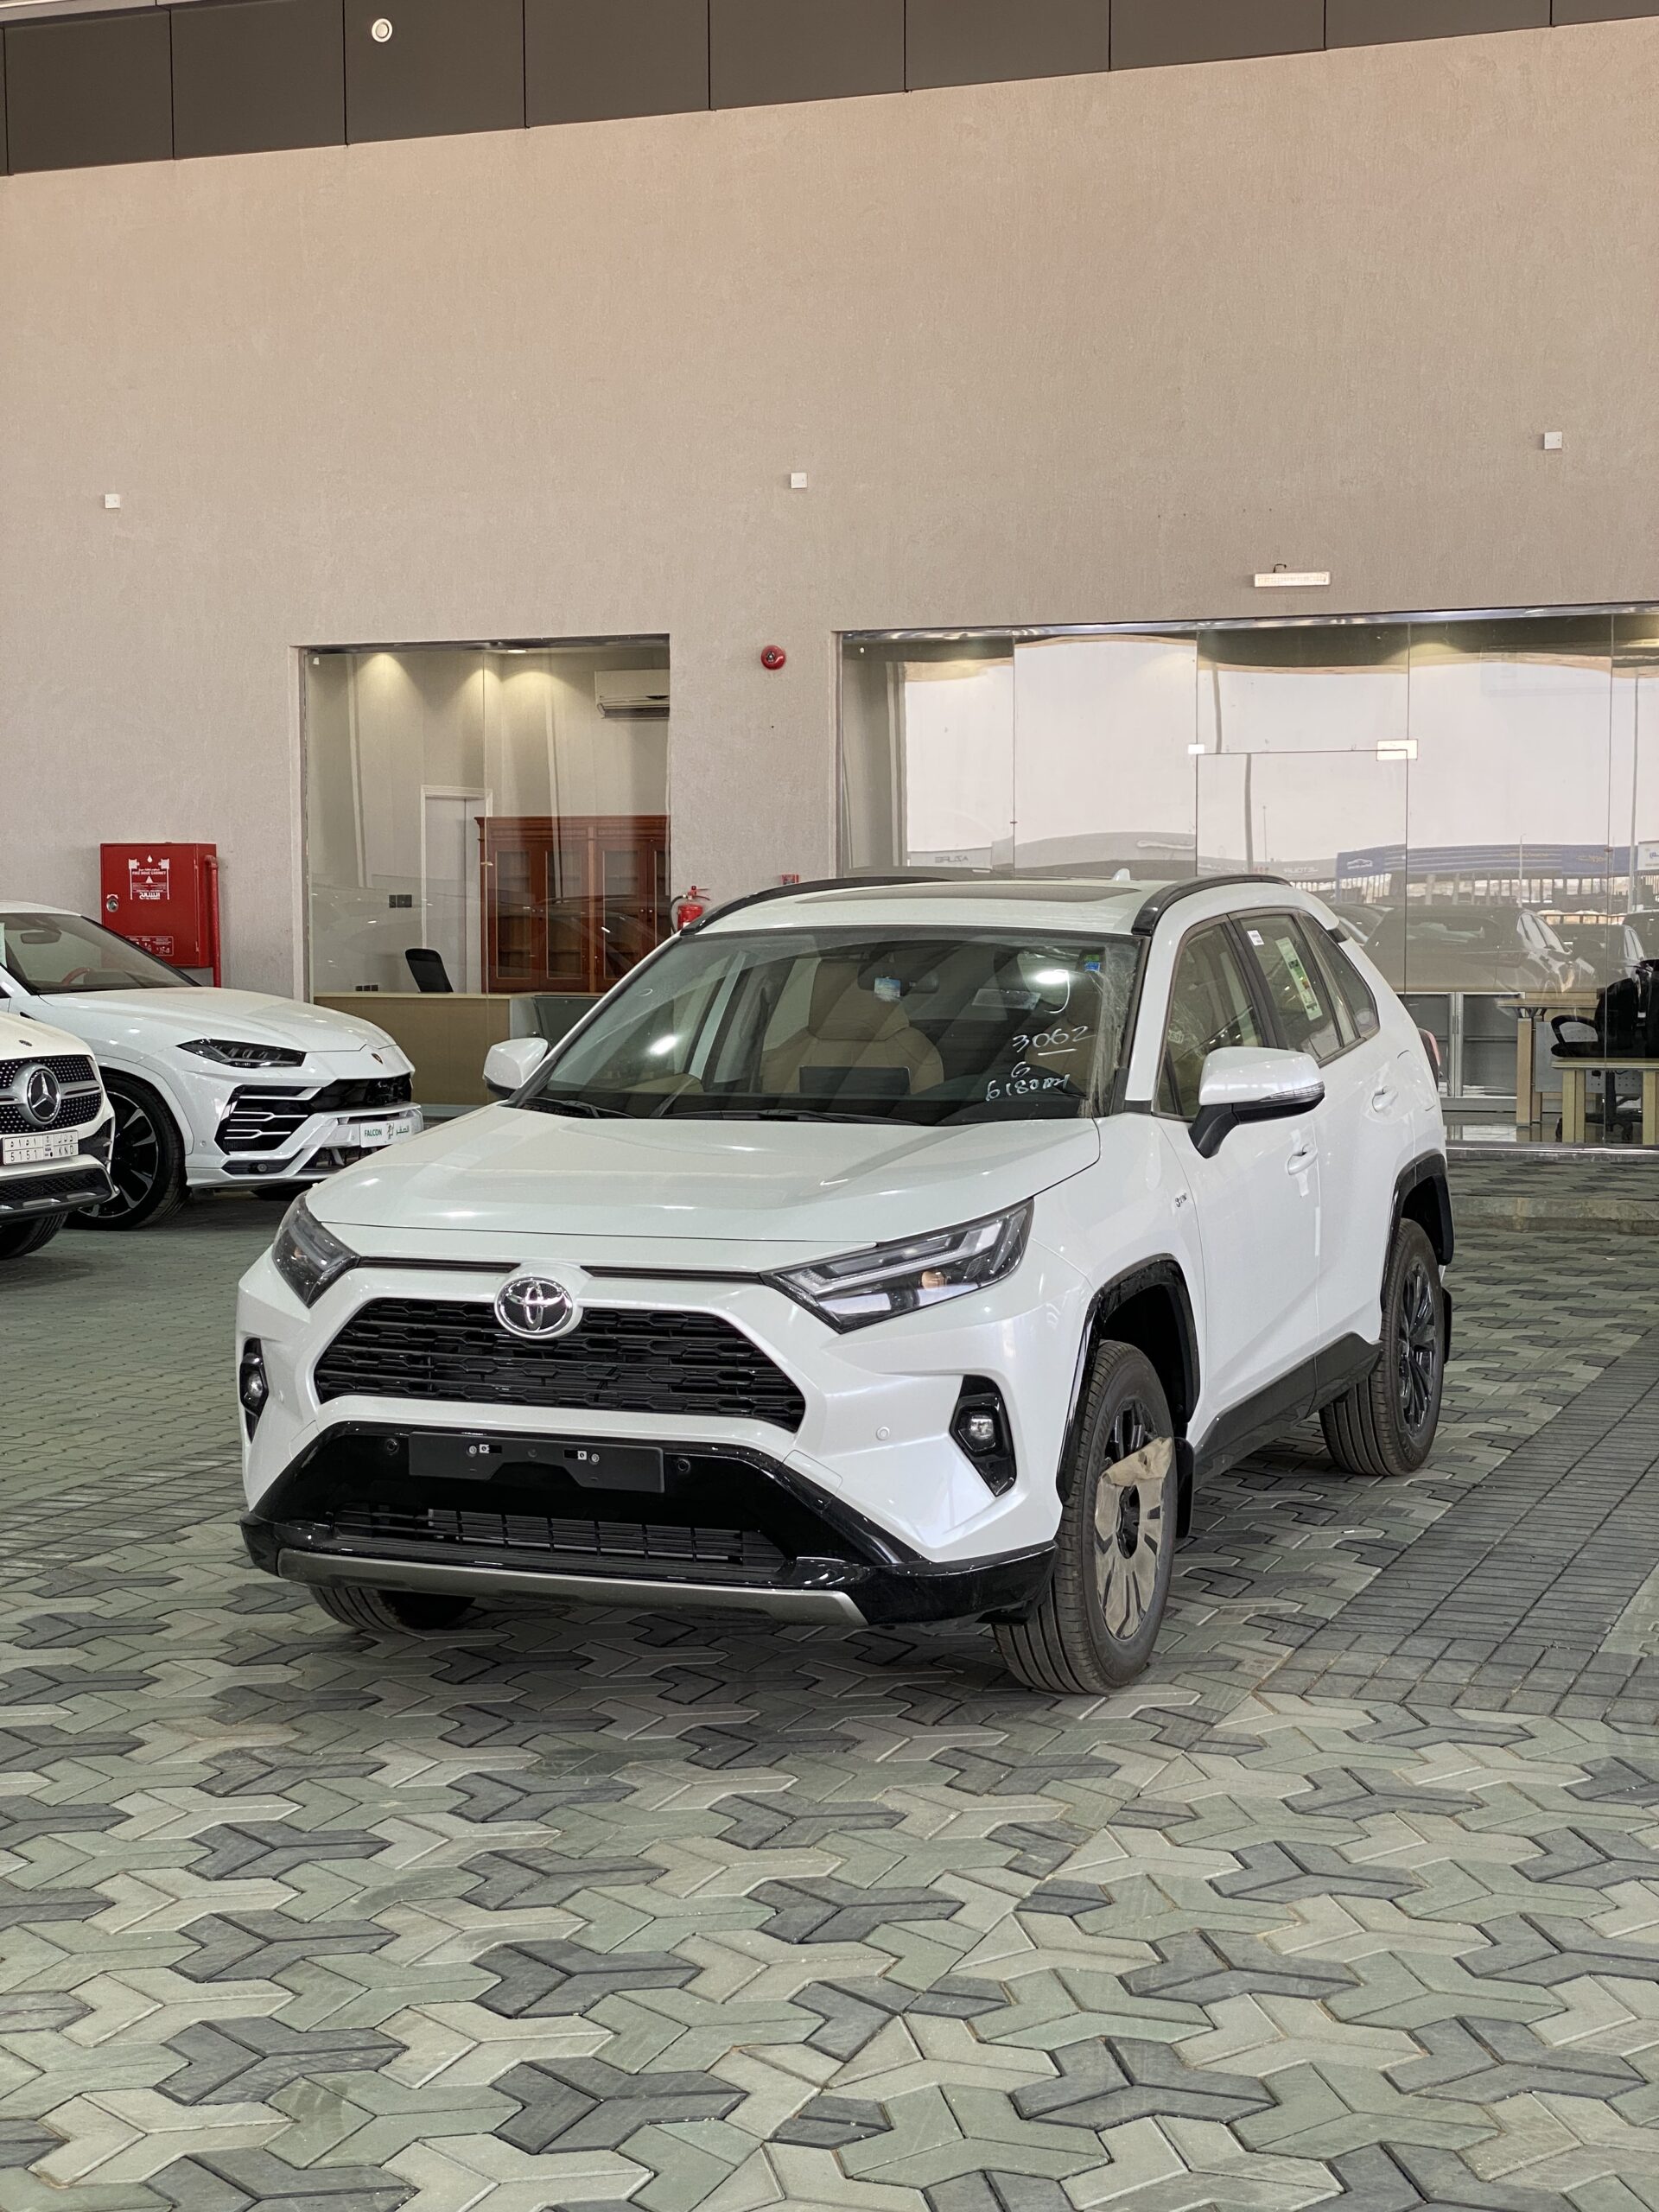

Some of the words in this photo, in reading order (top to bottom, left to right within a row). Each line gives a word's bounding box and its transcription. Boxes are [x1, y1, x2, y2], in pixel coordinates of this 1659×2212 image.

[1012, 1026, 1096, 1052] 3062
[364, 1128, 382, 1137] FALCON
[10, 1149, 38, 1161] 5151
